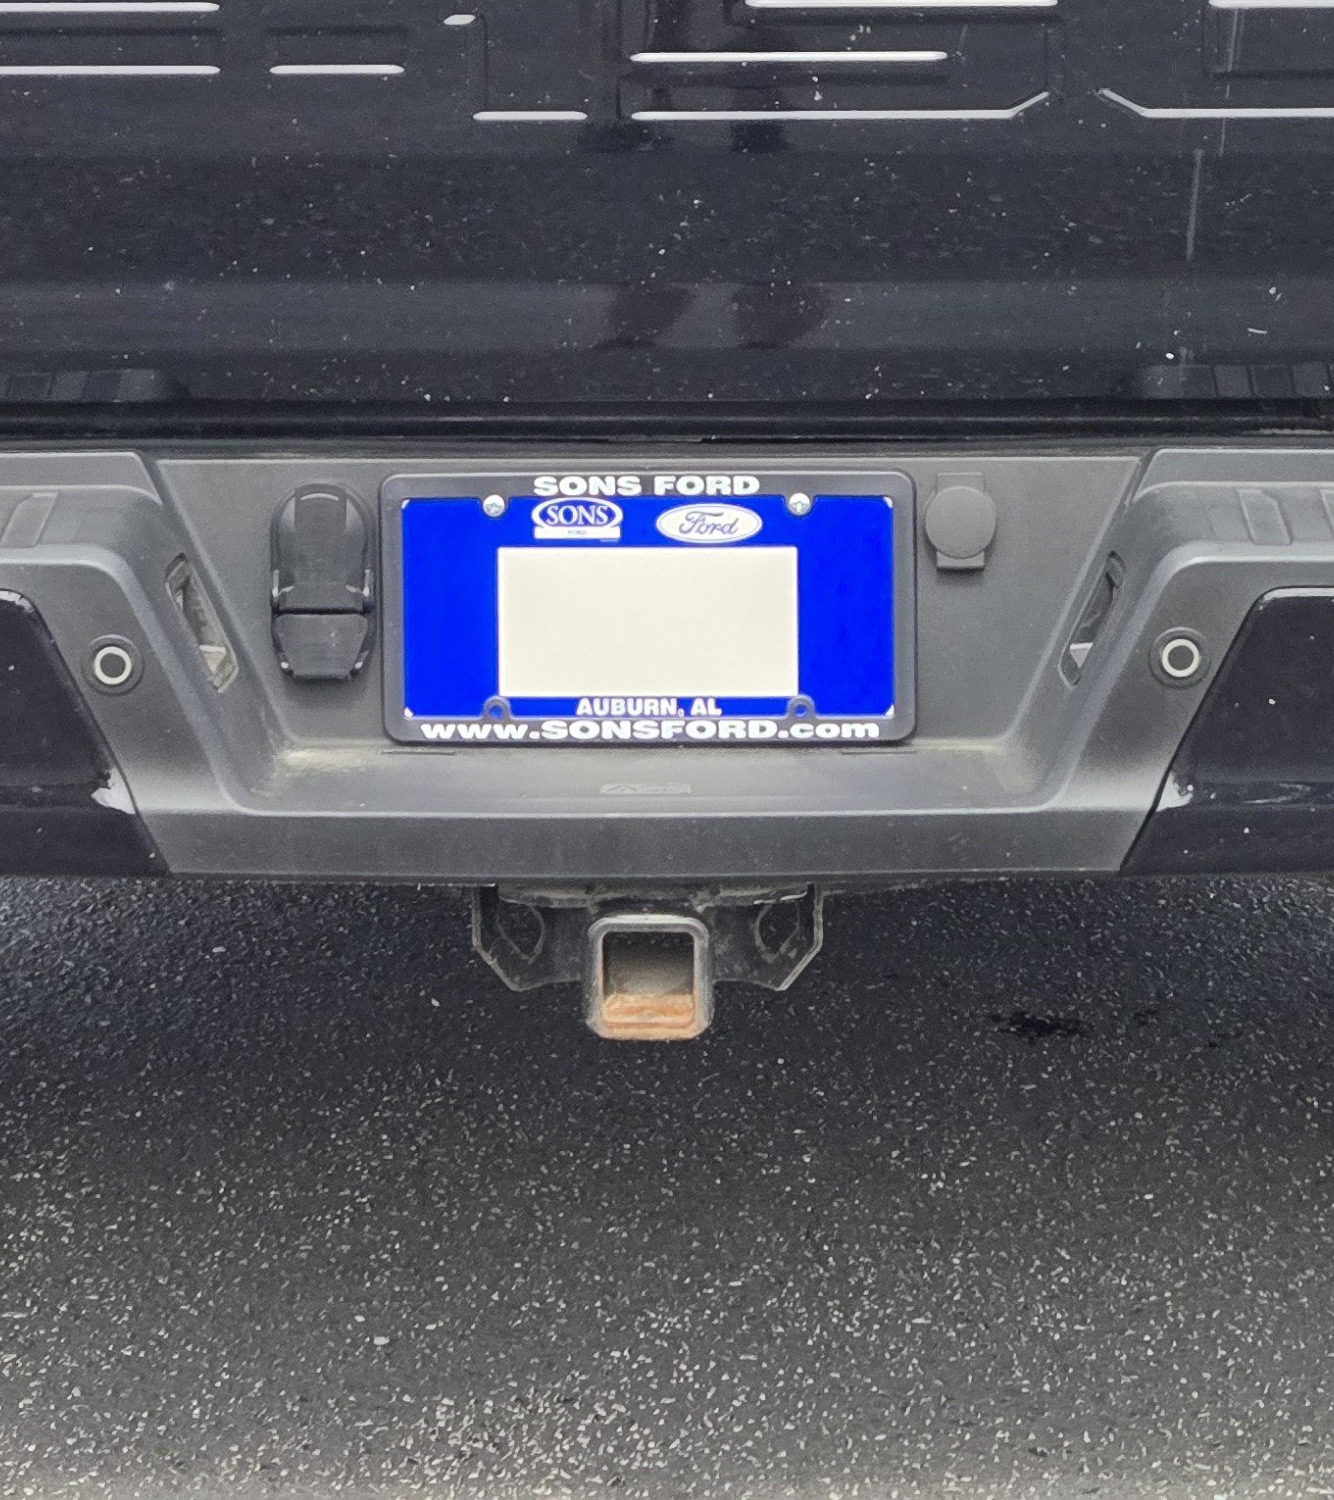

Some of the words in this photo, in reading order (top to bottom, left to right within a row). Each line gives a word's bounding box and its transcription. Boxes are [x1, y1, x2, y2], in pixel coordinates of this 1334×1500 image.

[534, 476, 642, 496] SONS
[654, 475, 760, 496] FORD
[546, 505, 609, 525] SONS
[678, 510, 739, 535] Ford
[576, 698, 684, 717] AUBURN,
[690, 697, 722, 716] AL
[421, 720, 880, 740] www.SONSFORD.com
